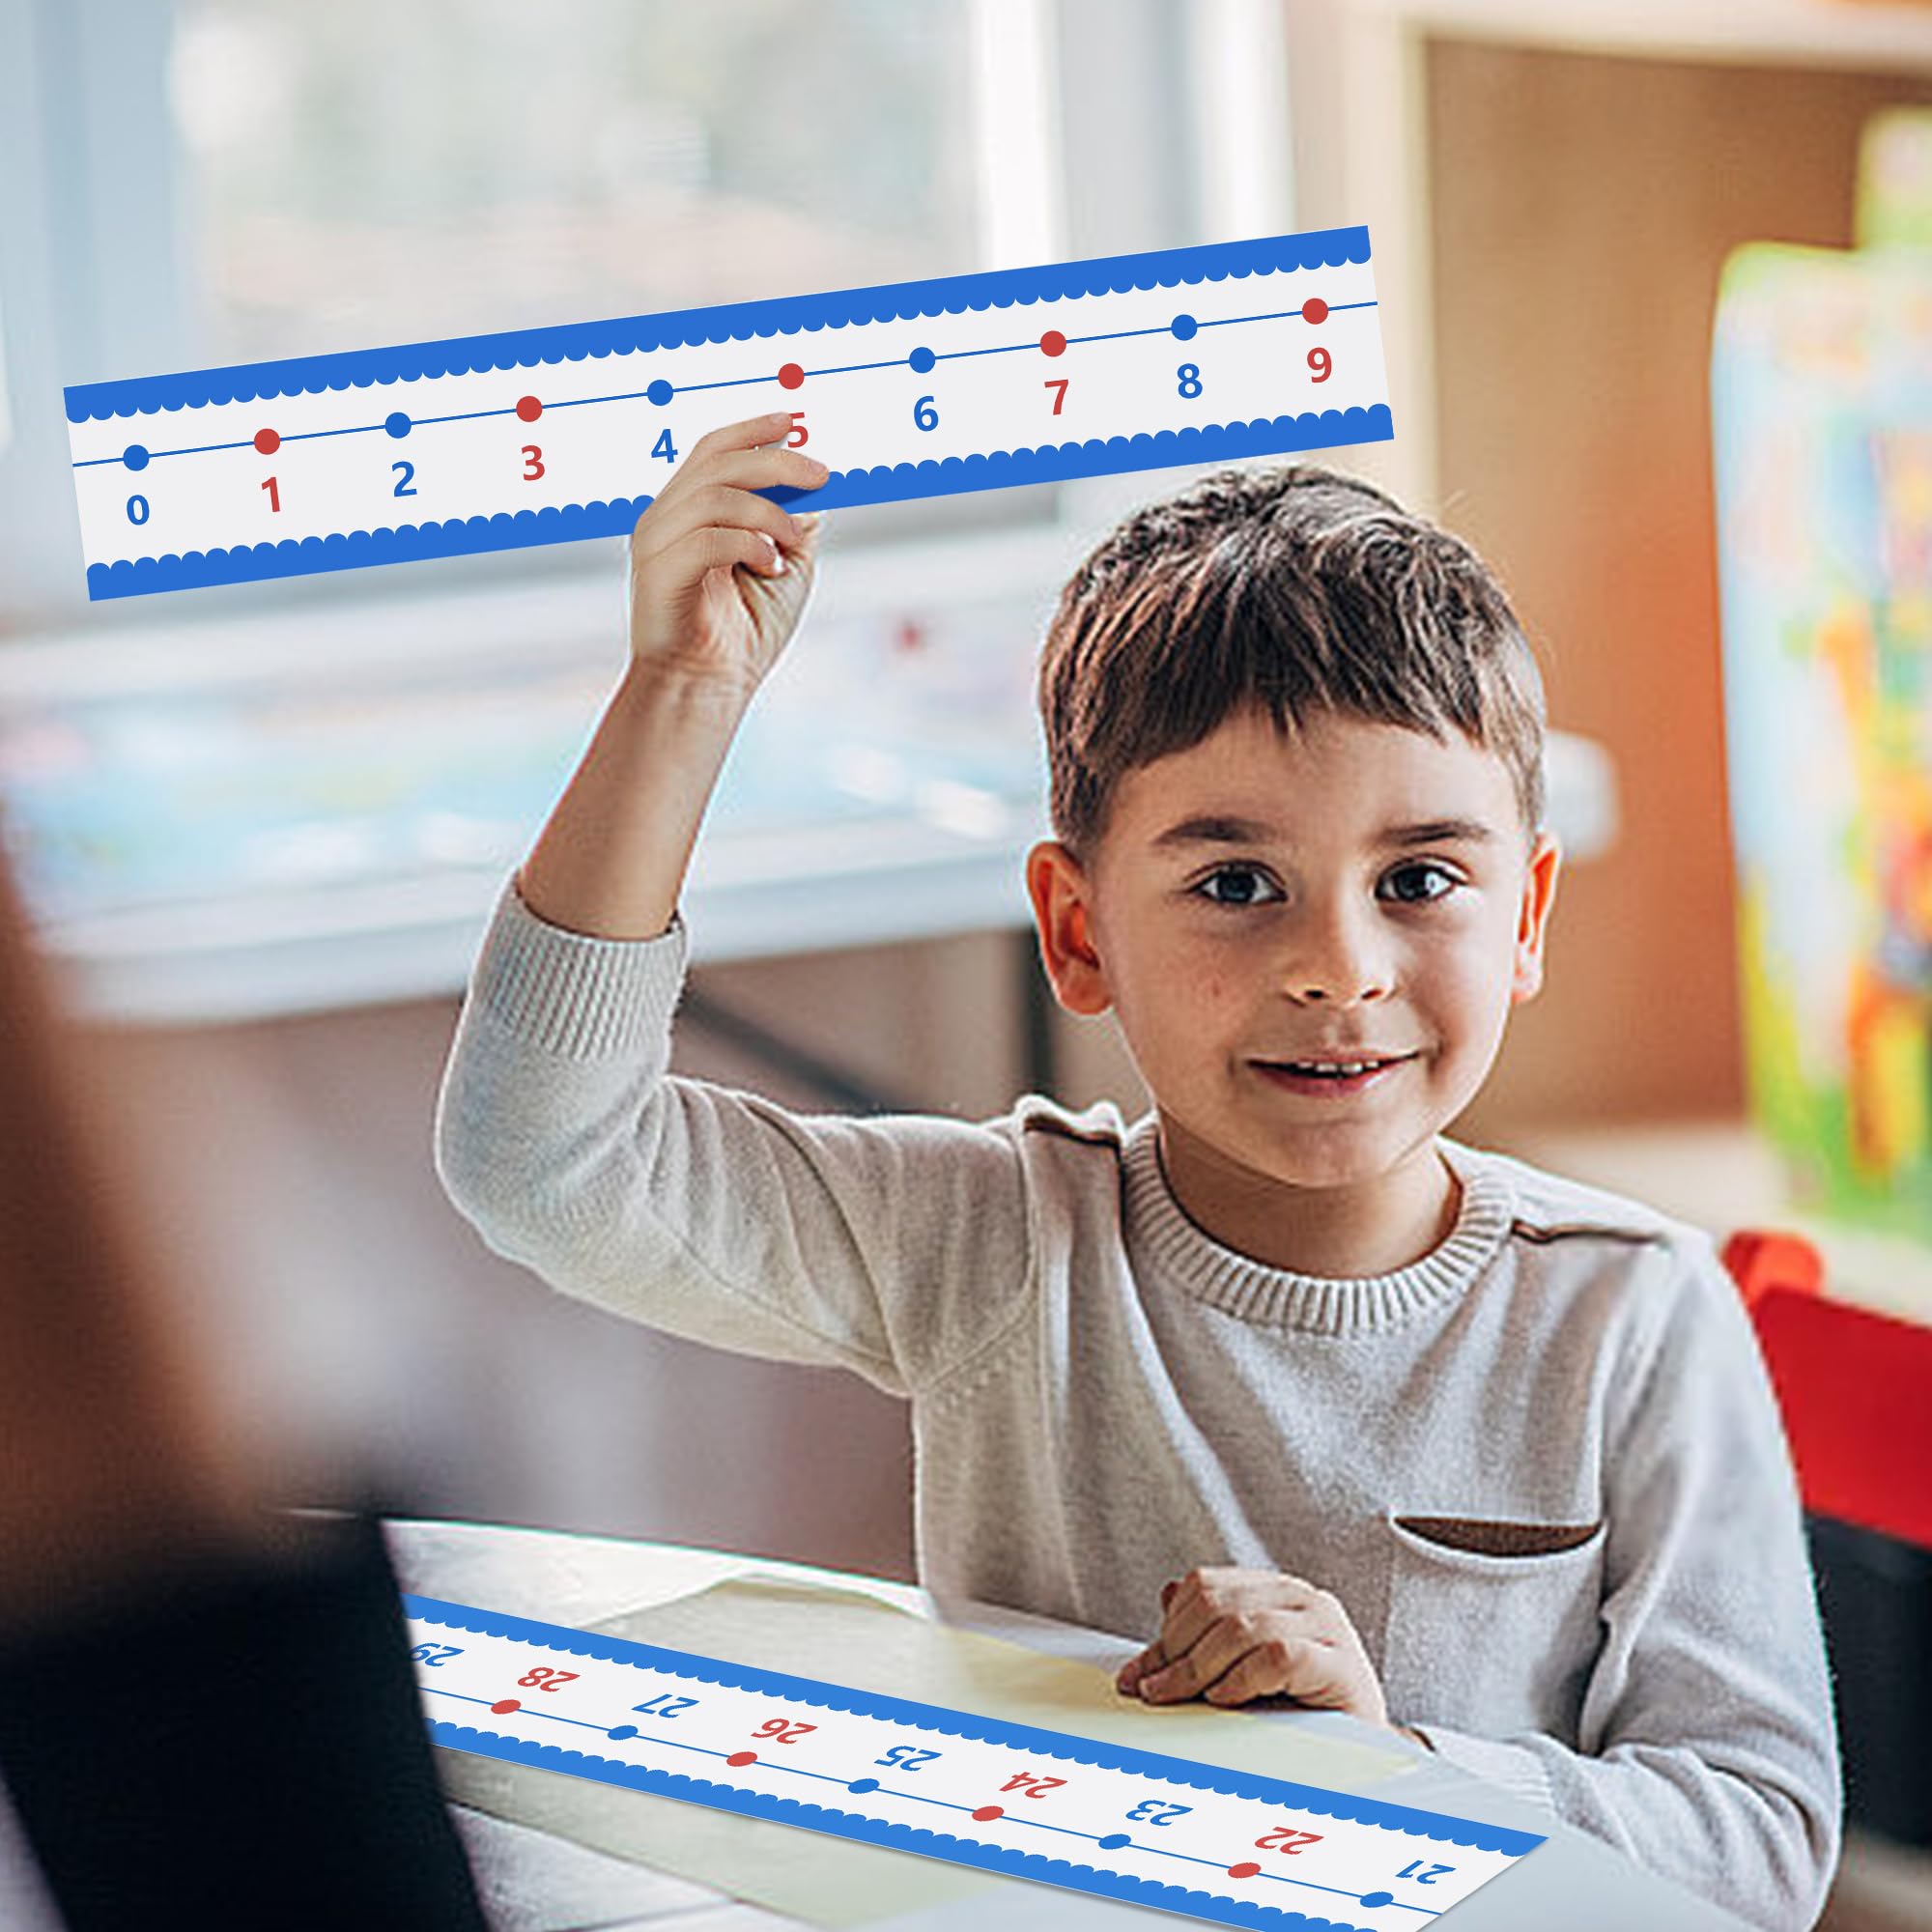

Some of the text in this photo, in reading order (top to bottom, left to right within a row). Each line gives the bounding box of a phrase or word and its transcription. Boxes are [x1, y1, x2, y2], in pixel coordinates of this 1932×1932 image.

[127, 347, 1333, 526] 0 1 2 3 4 5 6 7 8 9
[410, 1642, 1457, 1885] 21 22 23 24 25 26 27 28 29
